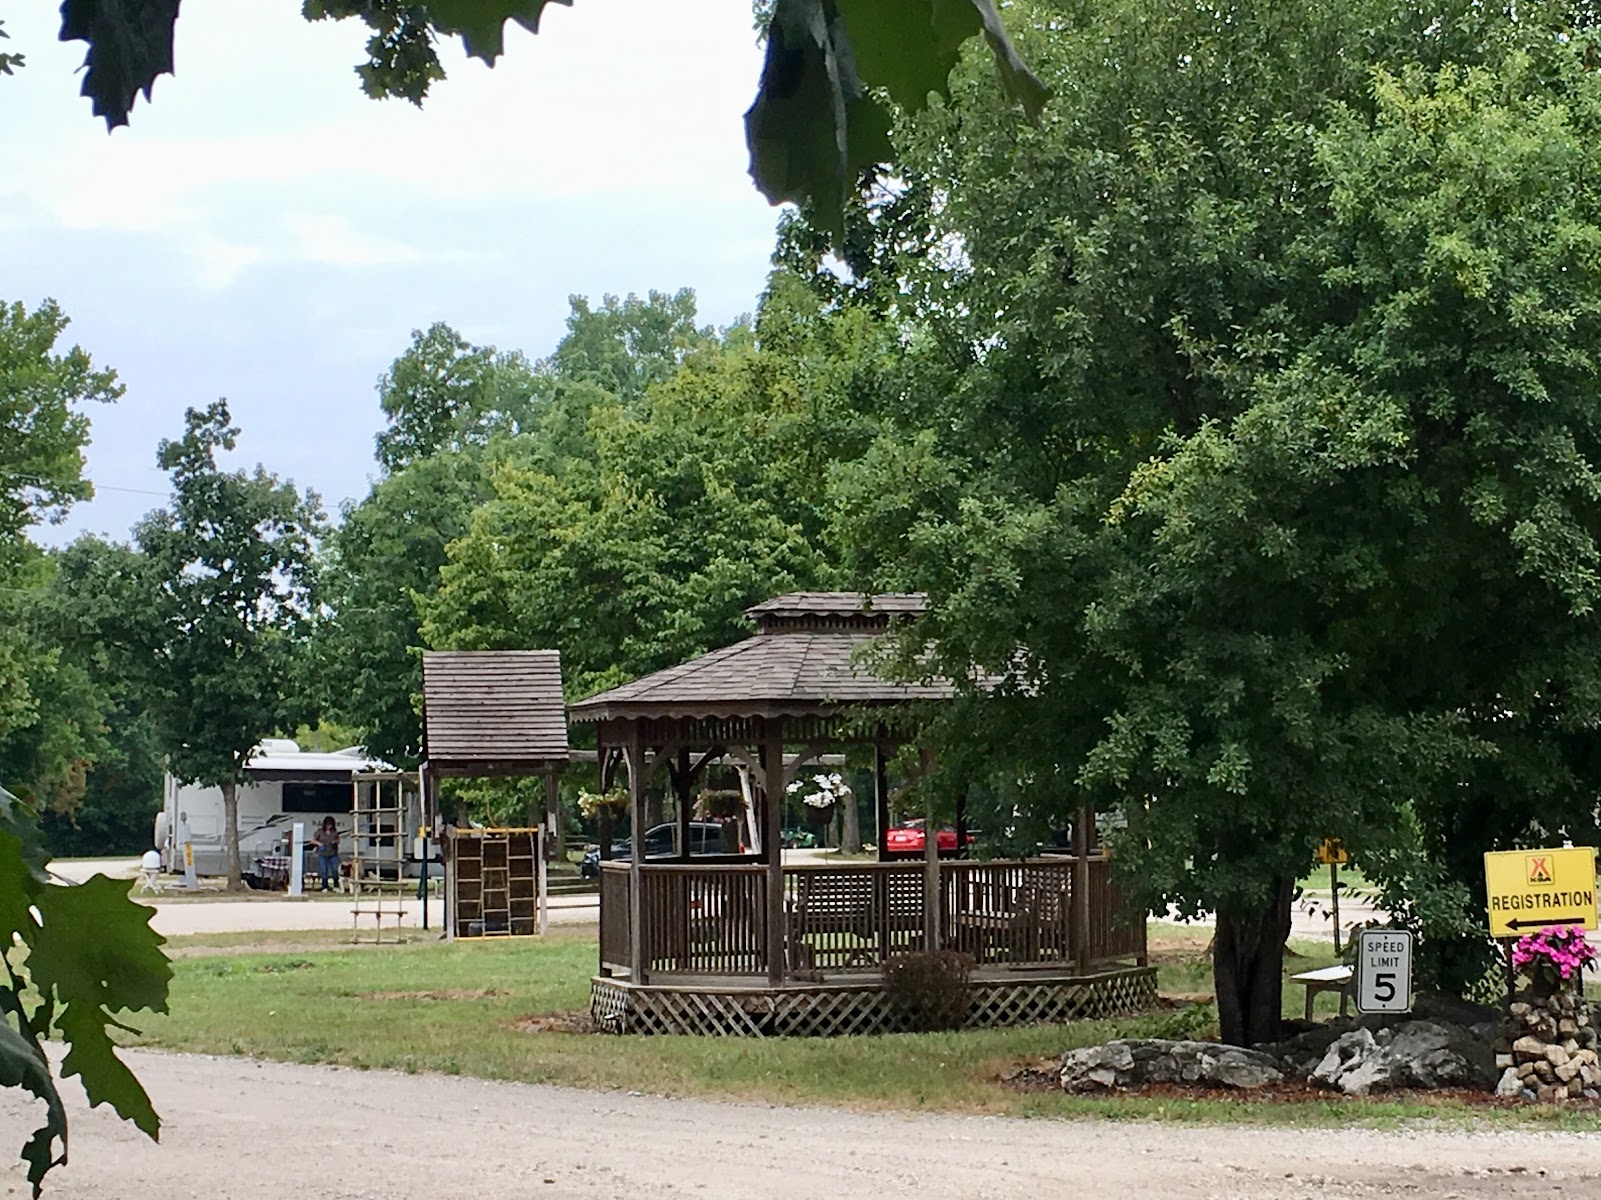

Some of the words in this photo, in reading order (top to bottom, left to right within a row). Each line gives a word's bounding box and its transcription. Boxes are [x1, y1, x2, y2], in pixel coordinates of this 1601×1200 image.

[1492, 891, 1592, 910] REGISTRATION
[1368, 942, 1404, 952] SPEED
[1371, 957, 1399, 967] LIMIT
[1374, 973, 1396, 1001] 5
